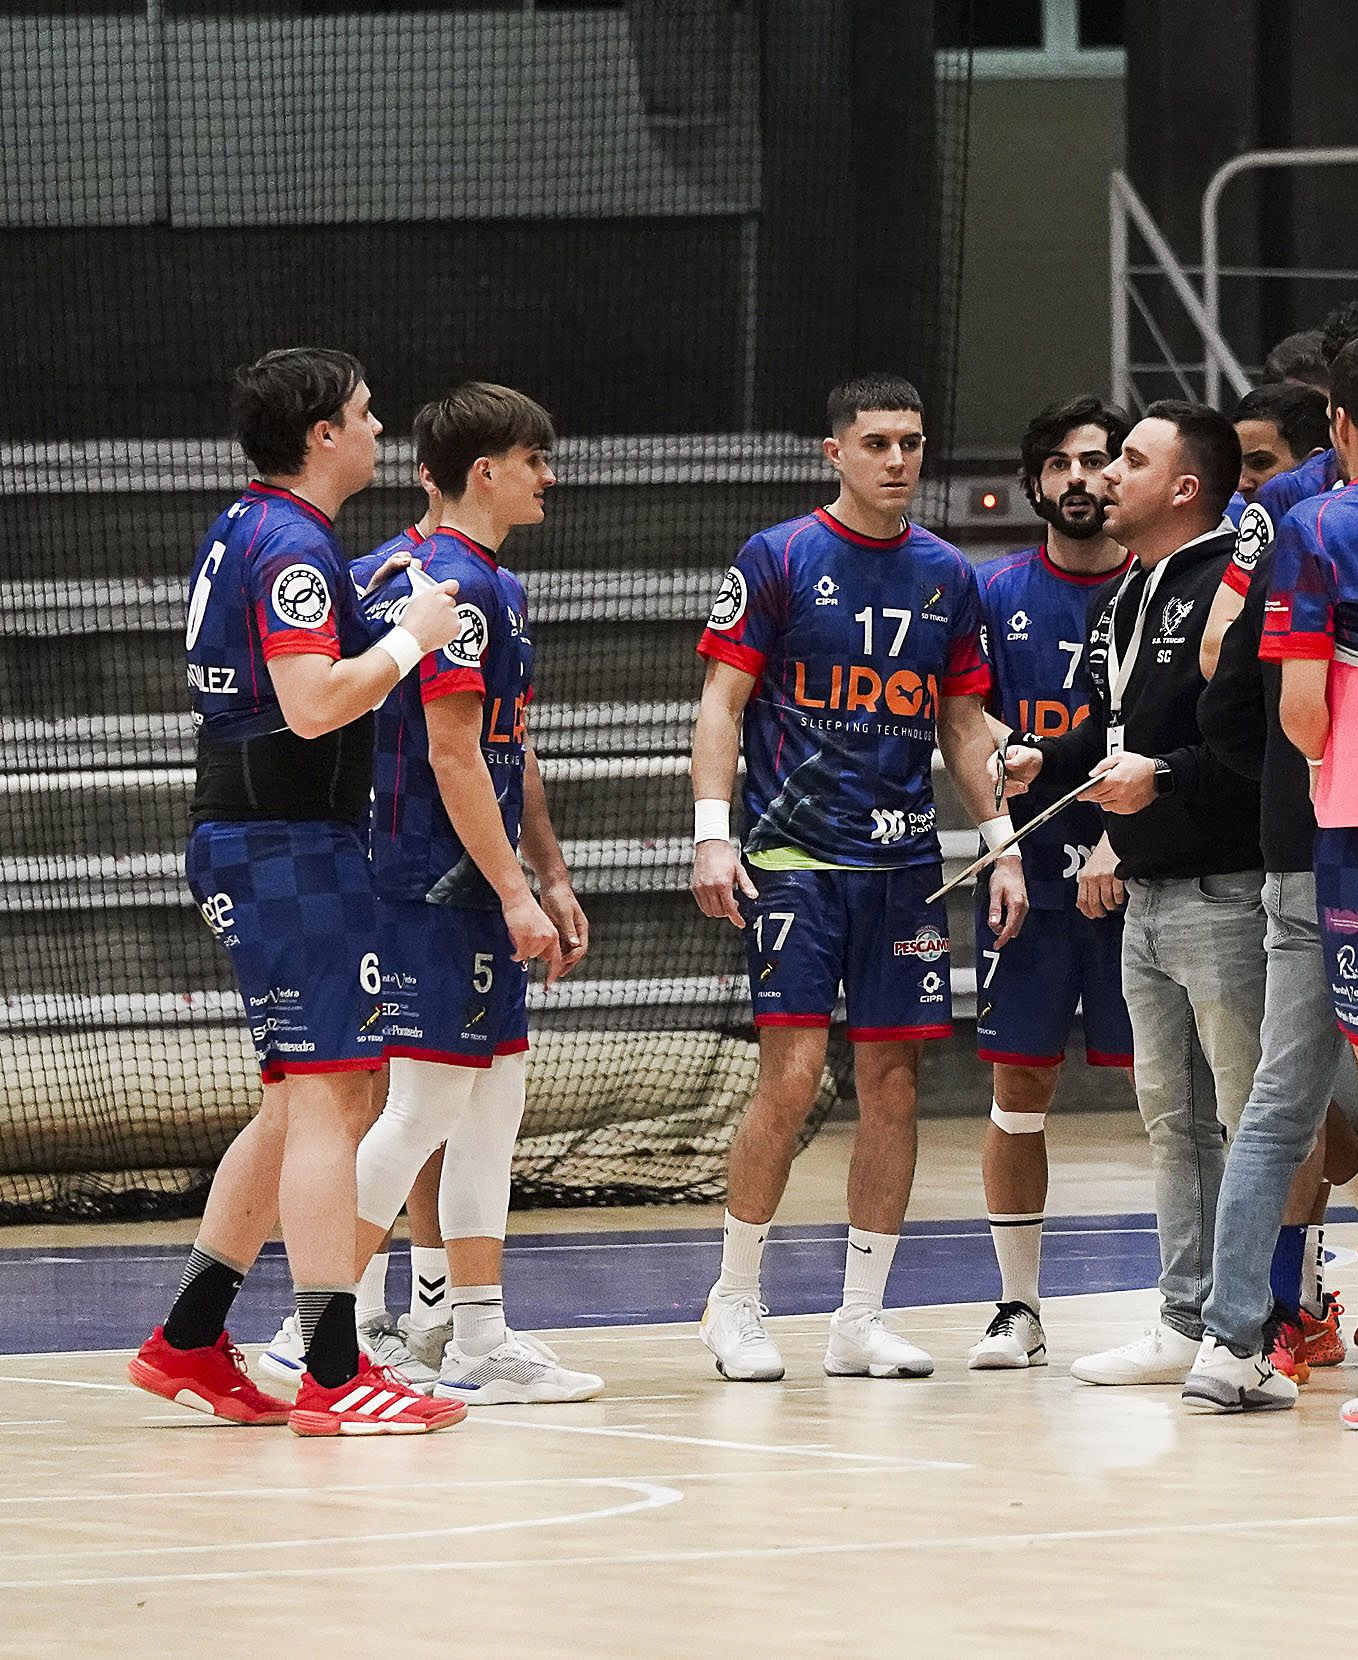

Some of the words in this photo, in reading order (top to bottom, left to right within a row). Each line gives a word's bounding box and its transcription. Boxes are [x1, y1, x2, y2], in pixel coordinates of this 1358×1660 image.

[185, 540, 226, 651] 6
[854, 606, 912, 658] 17
[1007, 633, 1029, 641] CIPA
[1059, 641, 1083, 689] 7
[801, 717, 869, 734] SLEEPING
[877, 724, 936, 742] TECHNOLOG
[753, 912, 795, 953] 17
[360, 952, 382, 995] 6
[472, 953, 493, 994] 5
[983, 950, 1000, 989] 7
[920, 995, 944, 1003] CIPA
